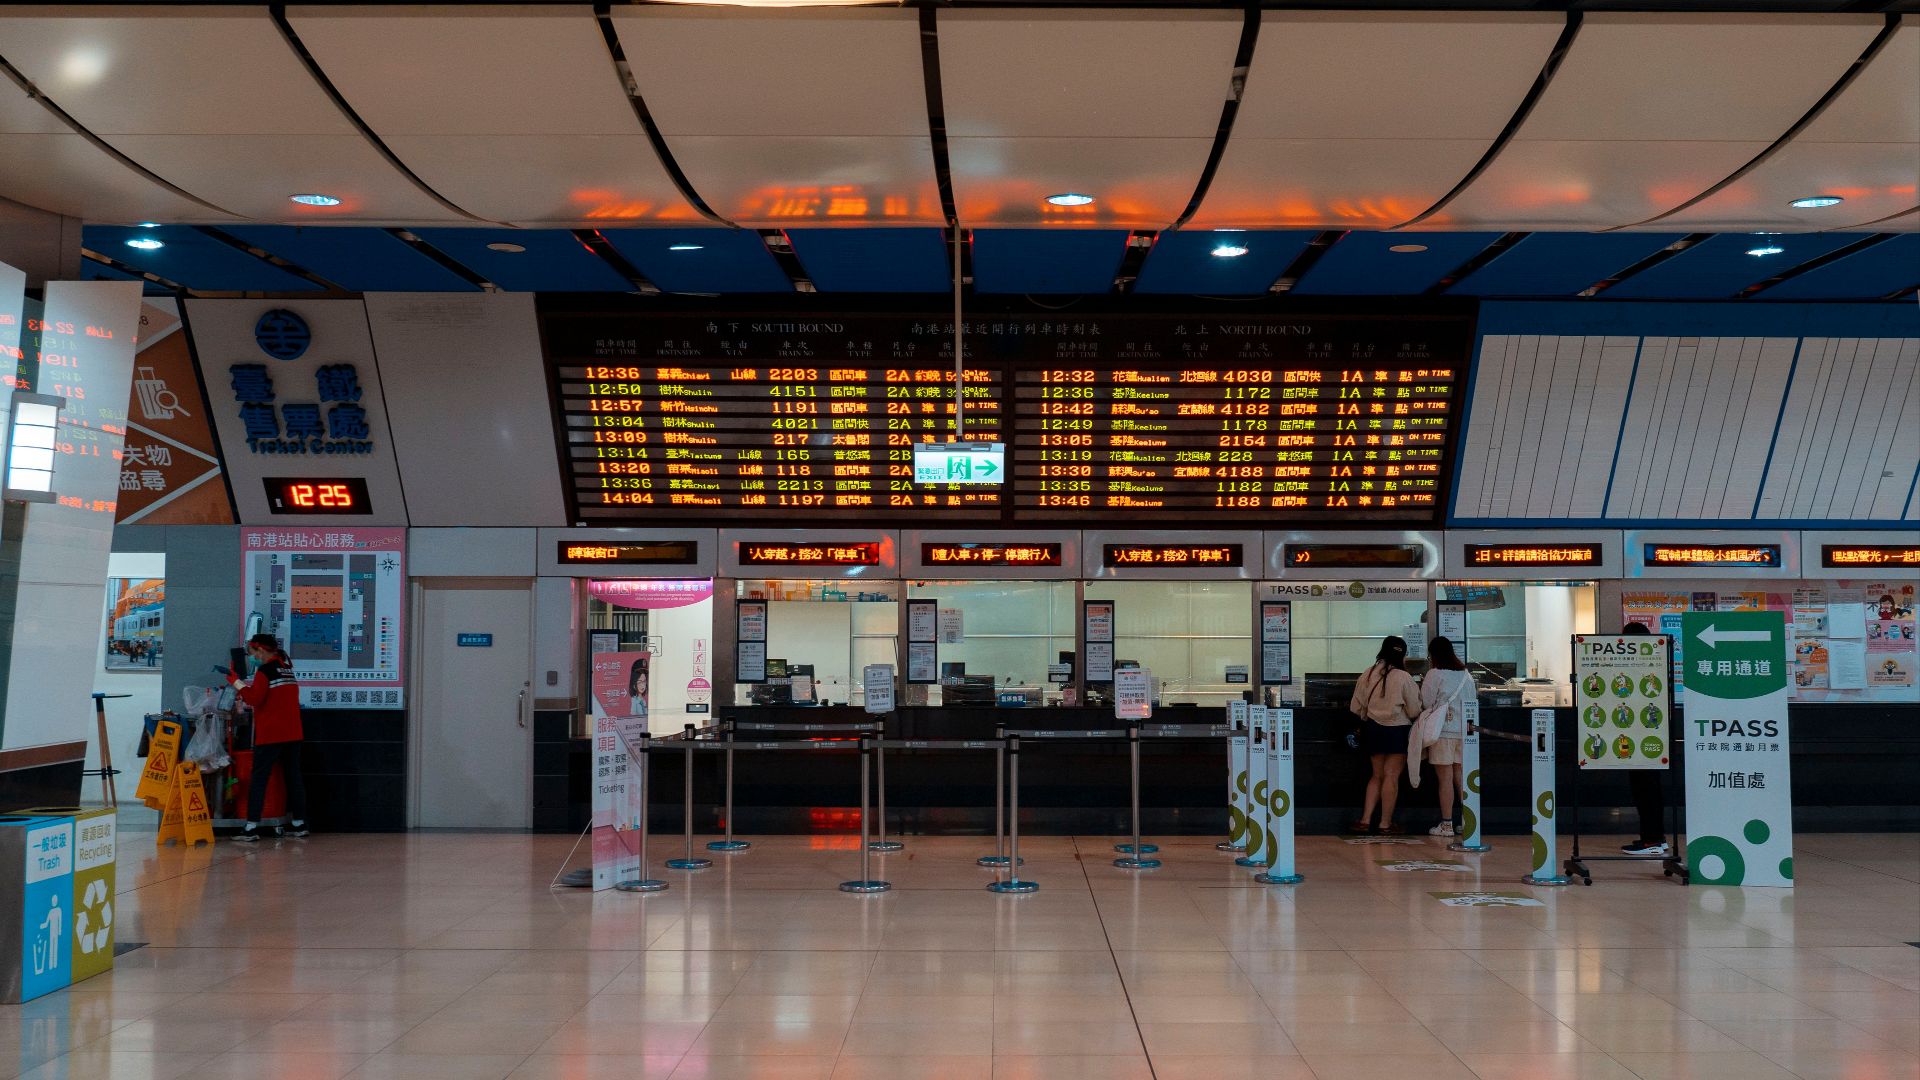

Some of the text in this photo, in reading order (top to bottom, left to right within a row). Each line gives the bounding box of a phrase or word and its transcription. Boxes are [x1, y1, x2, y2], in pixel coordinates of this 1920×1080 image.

[751, 323, 794, 334] SOUTH
[798, 323, 844, 334] BOUND
[1219, 325, 1263, 336] NORTH
[1267, 325, 1312, 336] BOUND
[586, 366, 641, 380] 12:36
[768, 368, 819, 381] 2203
[828, 368, 868, 382] 區間車
[885, 369, 911, 382] 2A
[1041, 370, 1095, 383] 12:32
[1222, 370, 1273, 383] 4030
[1283, 370, 1322, 383] 區間快
[1340, 370, 1364, 383] 1A
[588, 383, 641, 395] 12:50
[769, 385, 817, 397] 4151
[830, 385, 867, 398] 區間車
[887, 386, 911, 398] 2A
[1041, 386, 1094, 399] 12:36
[1224, 387, 1271, 399] 1172
[1282, 387, 1319, 399] 區間車
[1339, 387, 1361, 399] 1A
[590, 399, 644, 412] 12:57
[771, 401, 818, 414] 1191
[829, 401, 869, 414] 區間車
[886, 402, 912, 415] 2A
[1040, 402, 1094, 415] 12:42
[1220, 403, 1270, 416] 4182
[1280, 403, 1318, 416] 區間車
[1337, 403, 1361, 415] 1A
[593, 415, 645, 428] 13:04
[771, 418, 818, 430] 4021
[832, 418, 870, 430] 區間快
[888, 418, 912, 430] 2A
[1041, 418, 1093, 430] 12:49
[1221, 419, 1268, 431] 1178
[1279, 419, 1316, 431] 區間車
[1335, 419, 1358, 431] 1A
[594, 430, 648, 444] 13:09
[772, 433, 809, 446] 217
[831, 433, 871, 446] 太魯閣
[887, 433, 912, 446] 2A
[1040, 434, 1093, 446] 13:05
[1219, 435, 1267, 447] 2154
[1277, 434, 1316, 447] 區間車
[1333, 434, 1357, 446] 1A
[246, 437, 374, 455] Ticket Center
[597, 447, 649, 459] 13:14
[776, 449, 810, 461] 165
[833, 449, 871, 461] 普悠瑪
[889, 449, 912, 461] 2B
[1040, 449, 1092, 461] 13:19
[1218, 451, 1253, 462] 228
[1276, 450, 1313, 462] 普悠瑪
[1332, 450, 1354, 461] 1A
[598, 461, 651, 474] 13:20
[776, 464, 811, 476] 118
[833, 464, 872, 477] 區間車
[889, 464, 913, 476] 2A
[1039, 464, 1093, 477] 13:30
[1215, 465, 1265, 478] 4188
[1274, 465, 1312, 478] 區間車
[1330, 465, 1353, 477] 1A
[601, 477, 653, 489] 13:36
[777, 480, 824, 491] 2213
[835, 480, 872, 491] 區間車
[890, 480, 913, 491] 2A
[1039, 480, 1091, 492] 13:35
[1216, 481, 1262, 492] 1182
[1273, 481, 1310, 492] 區間車
[1329, 481, 1350, 492] 1A
[602, 492, 655, 504] 14:04
[779, 494, 825, 506] 1197
[835, 494, 873, 506] 區間車
[889, 494, 914, 506] 2A
[1039, 494, 1091, 507] 13:46
[1215, 495, 1261, 507] 1188
[1271, 495, 1308, 507] 區間車
[1326, 495, 1349, 507] 1A
[247, 533, 356, 548] 南港站貼心服務
[1269, 585, 1309, 595] TPASS
[1581, 642, 1637, 655] TPASS
[1696, 659, 1772, 676] 專用通道
[1694, 719, 1779, 737] TPASS
[1707, 771, 1766, 789] 加值處
[598, 783, 625, 795] Ticketing
[32, 832, 68, 853] 一般垃圾
[79, 843, 113, 861] Recycling
[38, 855, 61, 872] Trash
